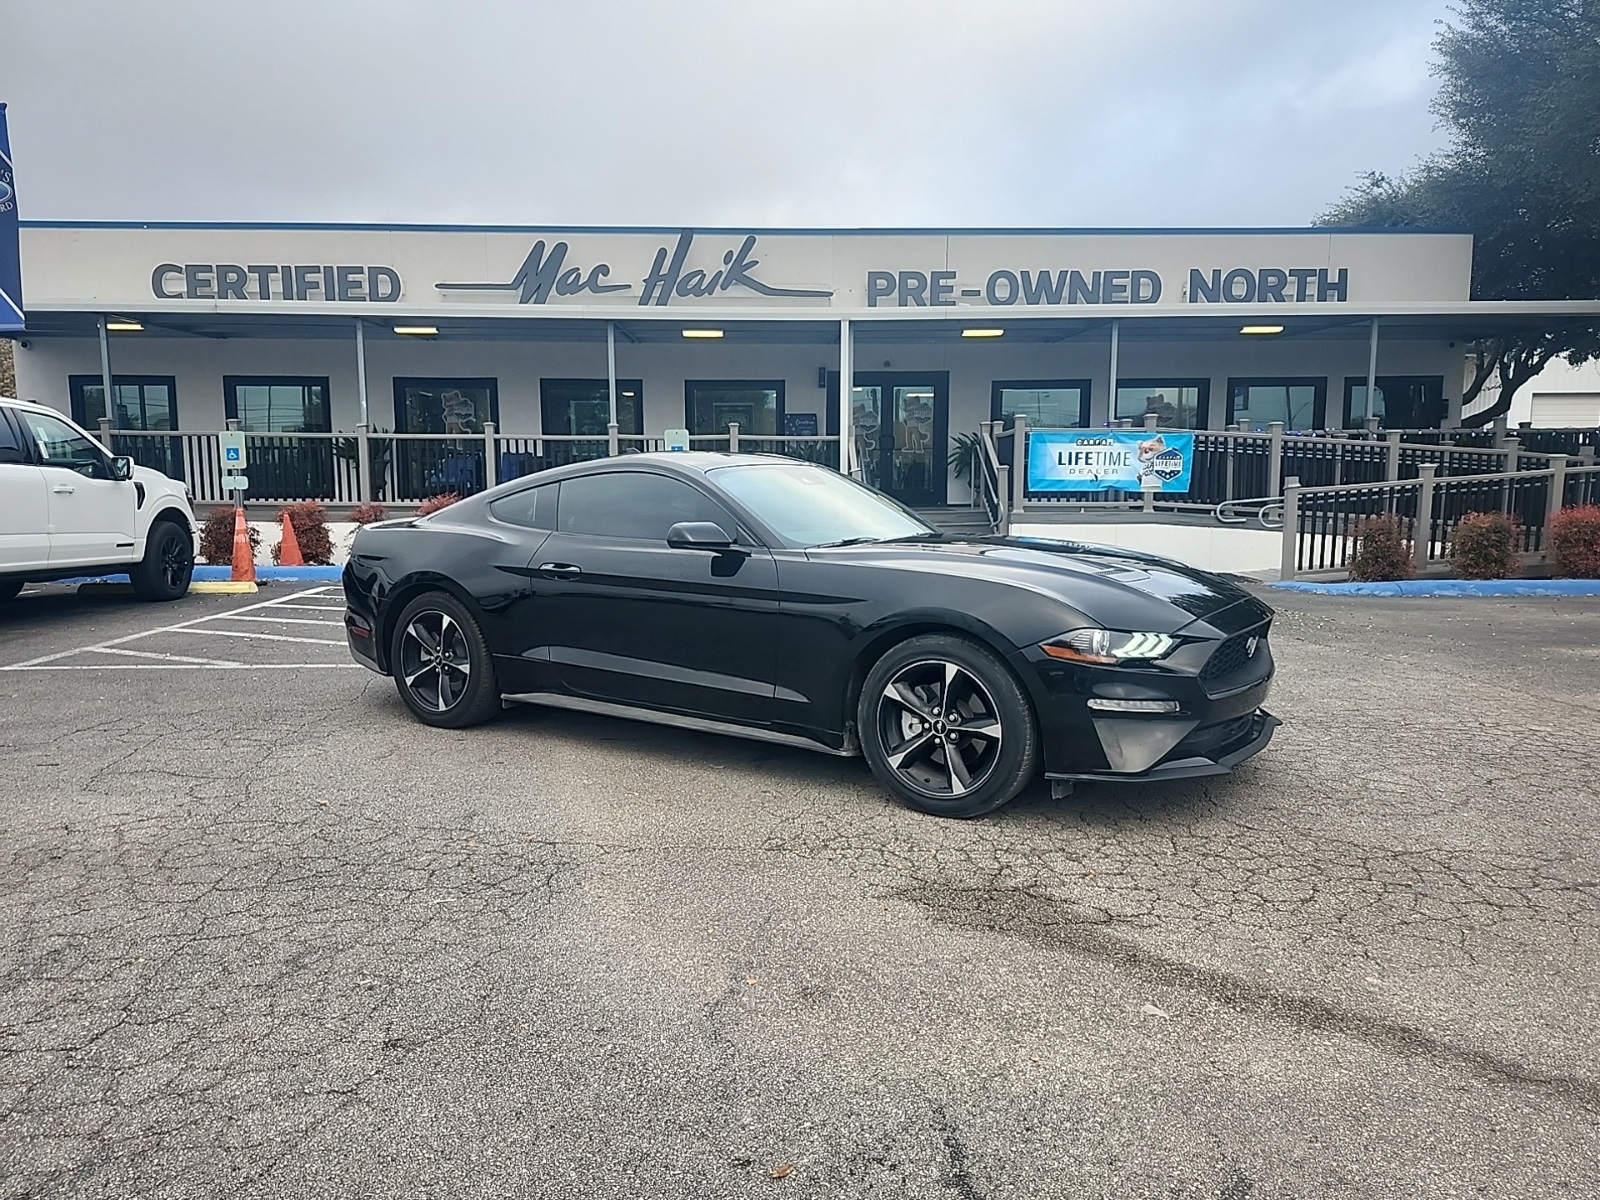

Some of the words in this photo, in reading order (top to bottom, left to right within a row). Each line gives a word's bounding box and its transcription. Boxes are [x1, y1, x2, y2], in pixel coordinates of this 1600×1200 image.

[151, 263, 402, 302] CERTIFIED
[435, 240, 632, 304] Mac
[637, 228, 834, 306] Haik
[866, 269, 1162, 306] PRE-OWNED
[1188, 267, 1349, 303] NORTH
[1058, 451, 1131, 466] LIFETIME
[1076, 438, 1113, 446] CARFAX
